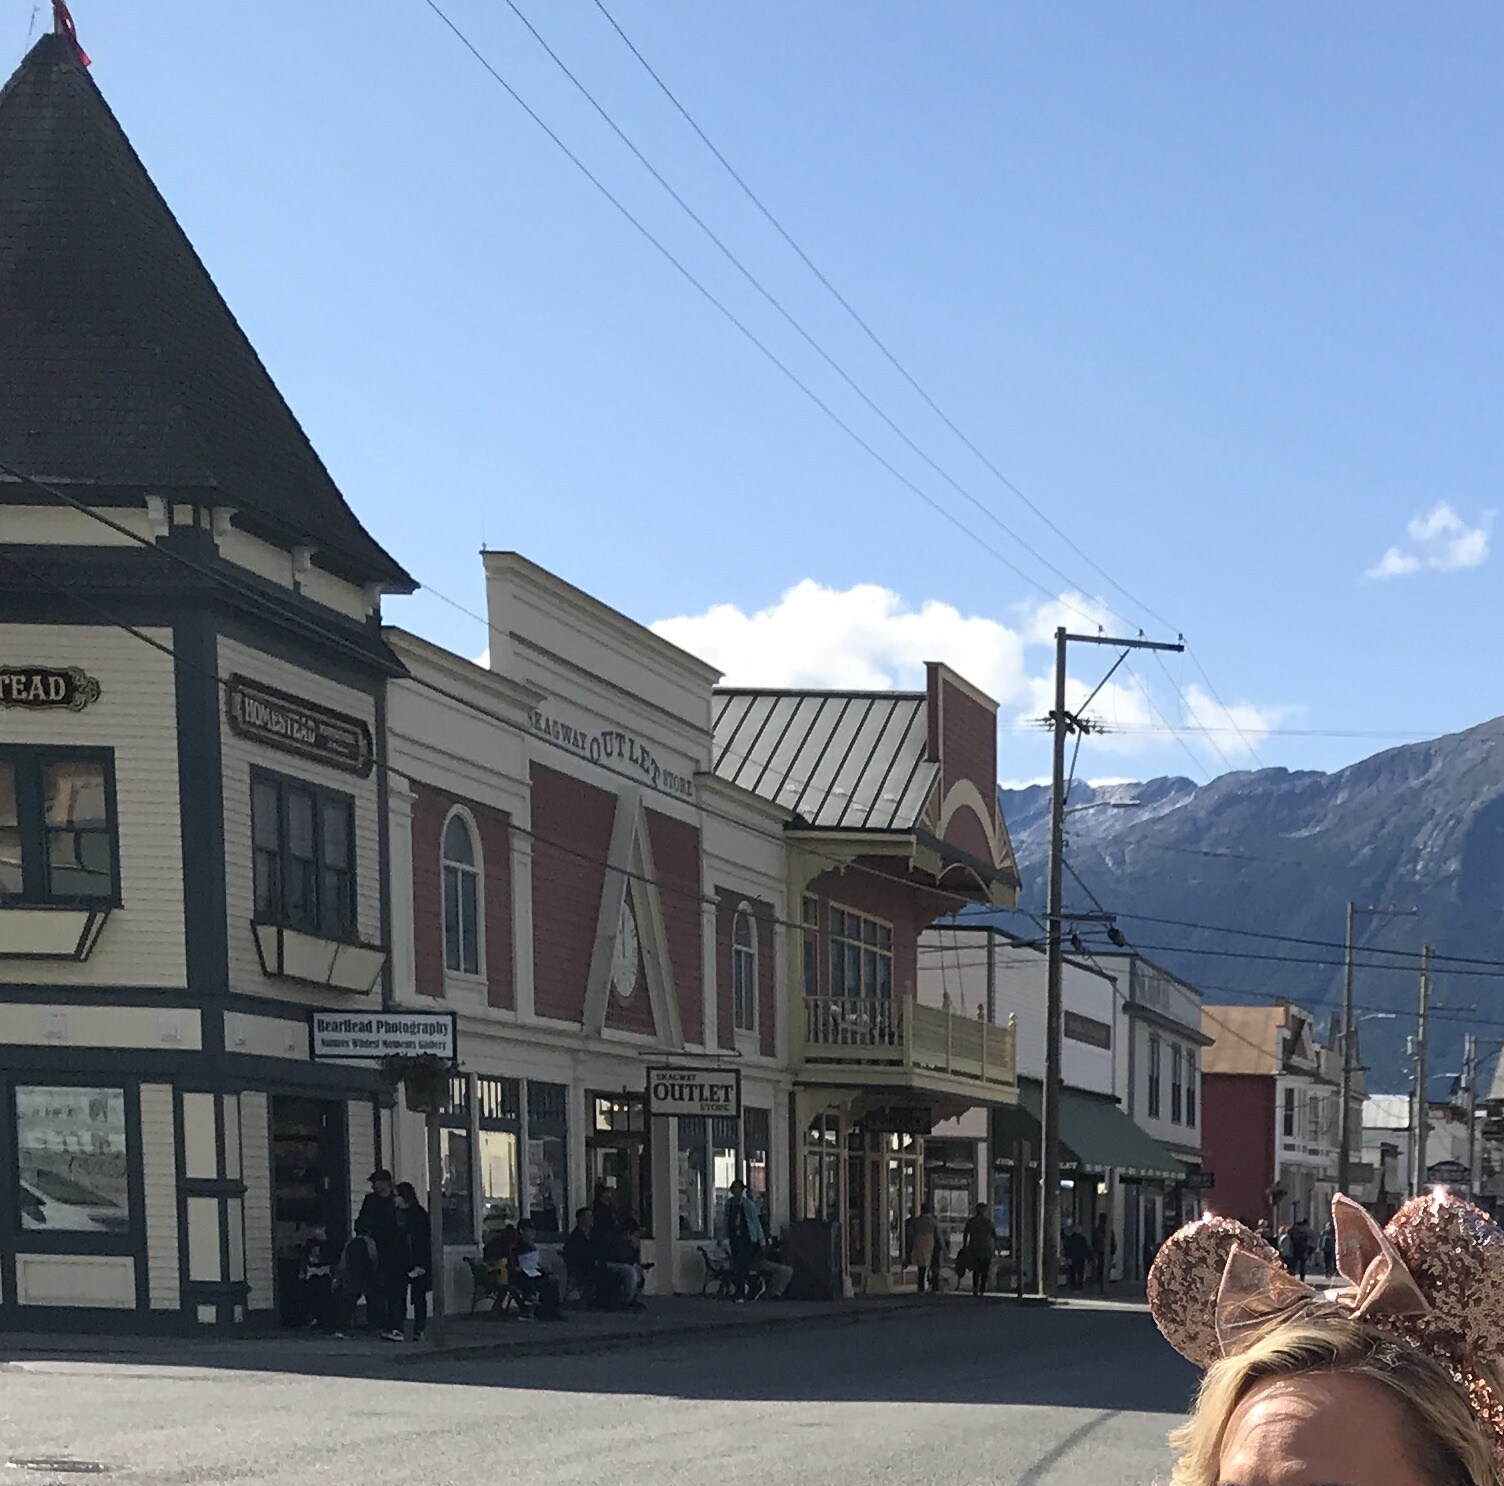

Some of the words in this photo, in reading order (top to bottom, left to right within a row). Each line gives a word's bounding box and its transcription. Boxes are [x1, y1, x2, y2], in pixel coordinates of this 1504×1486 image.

[245, 697, 316, 743] HOMESTEAD
[590, 730, 662, 788] OUTLET
[662, 769, 693, 796] STORE
[376, 1020, 449, 1037] Photography
[653, 1082, 734, 1103] OUTLET
